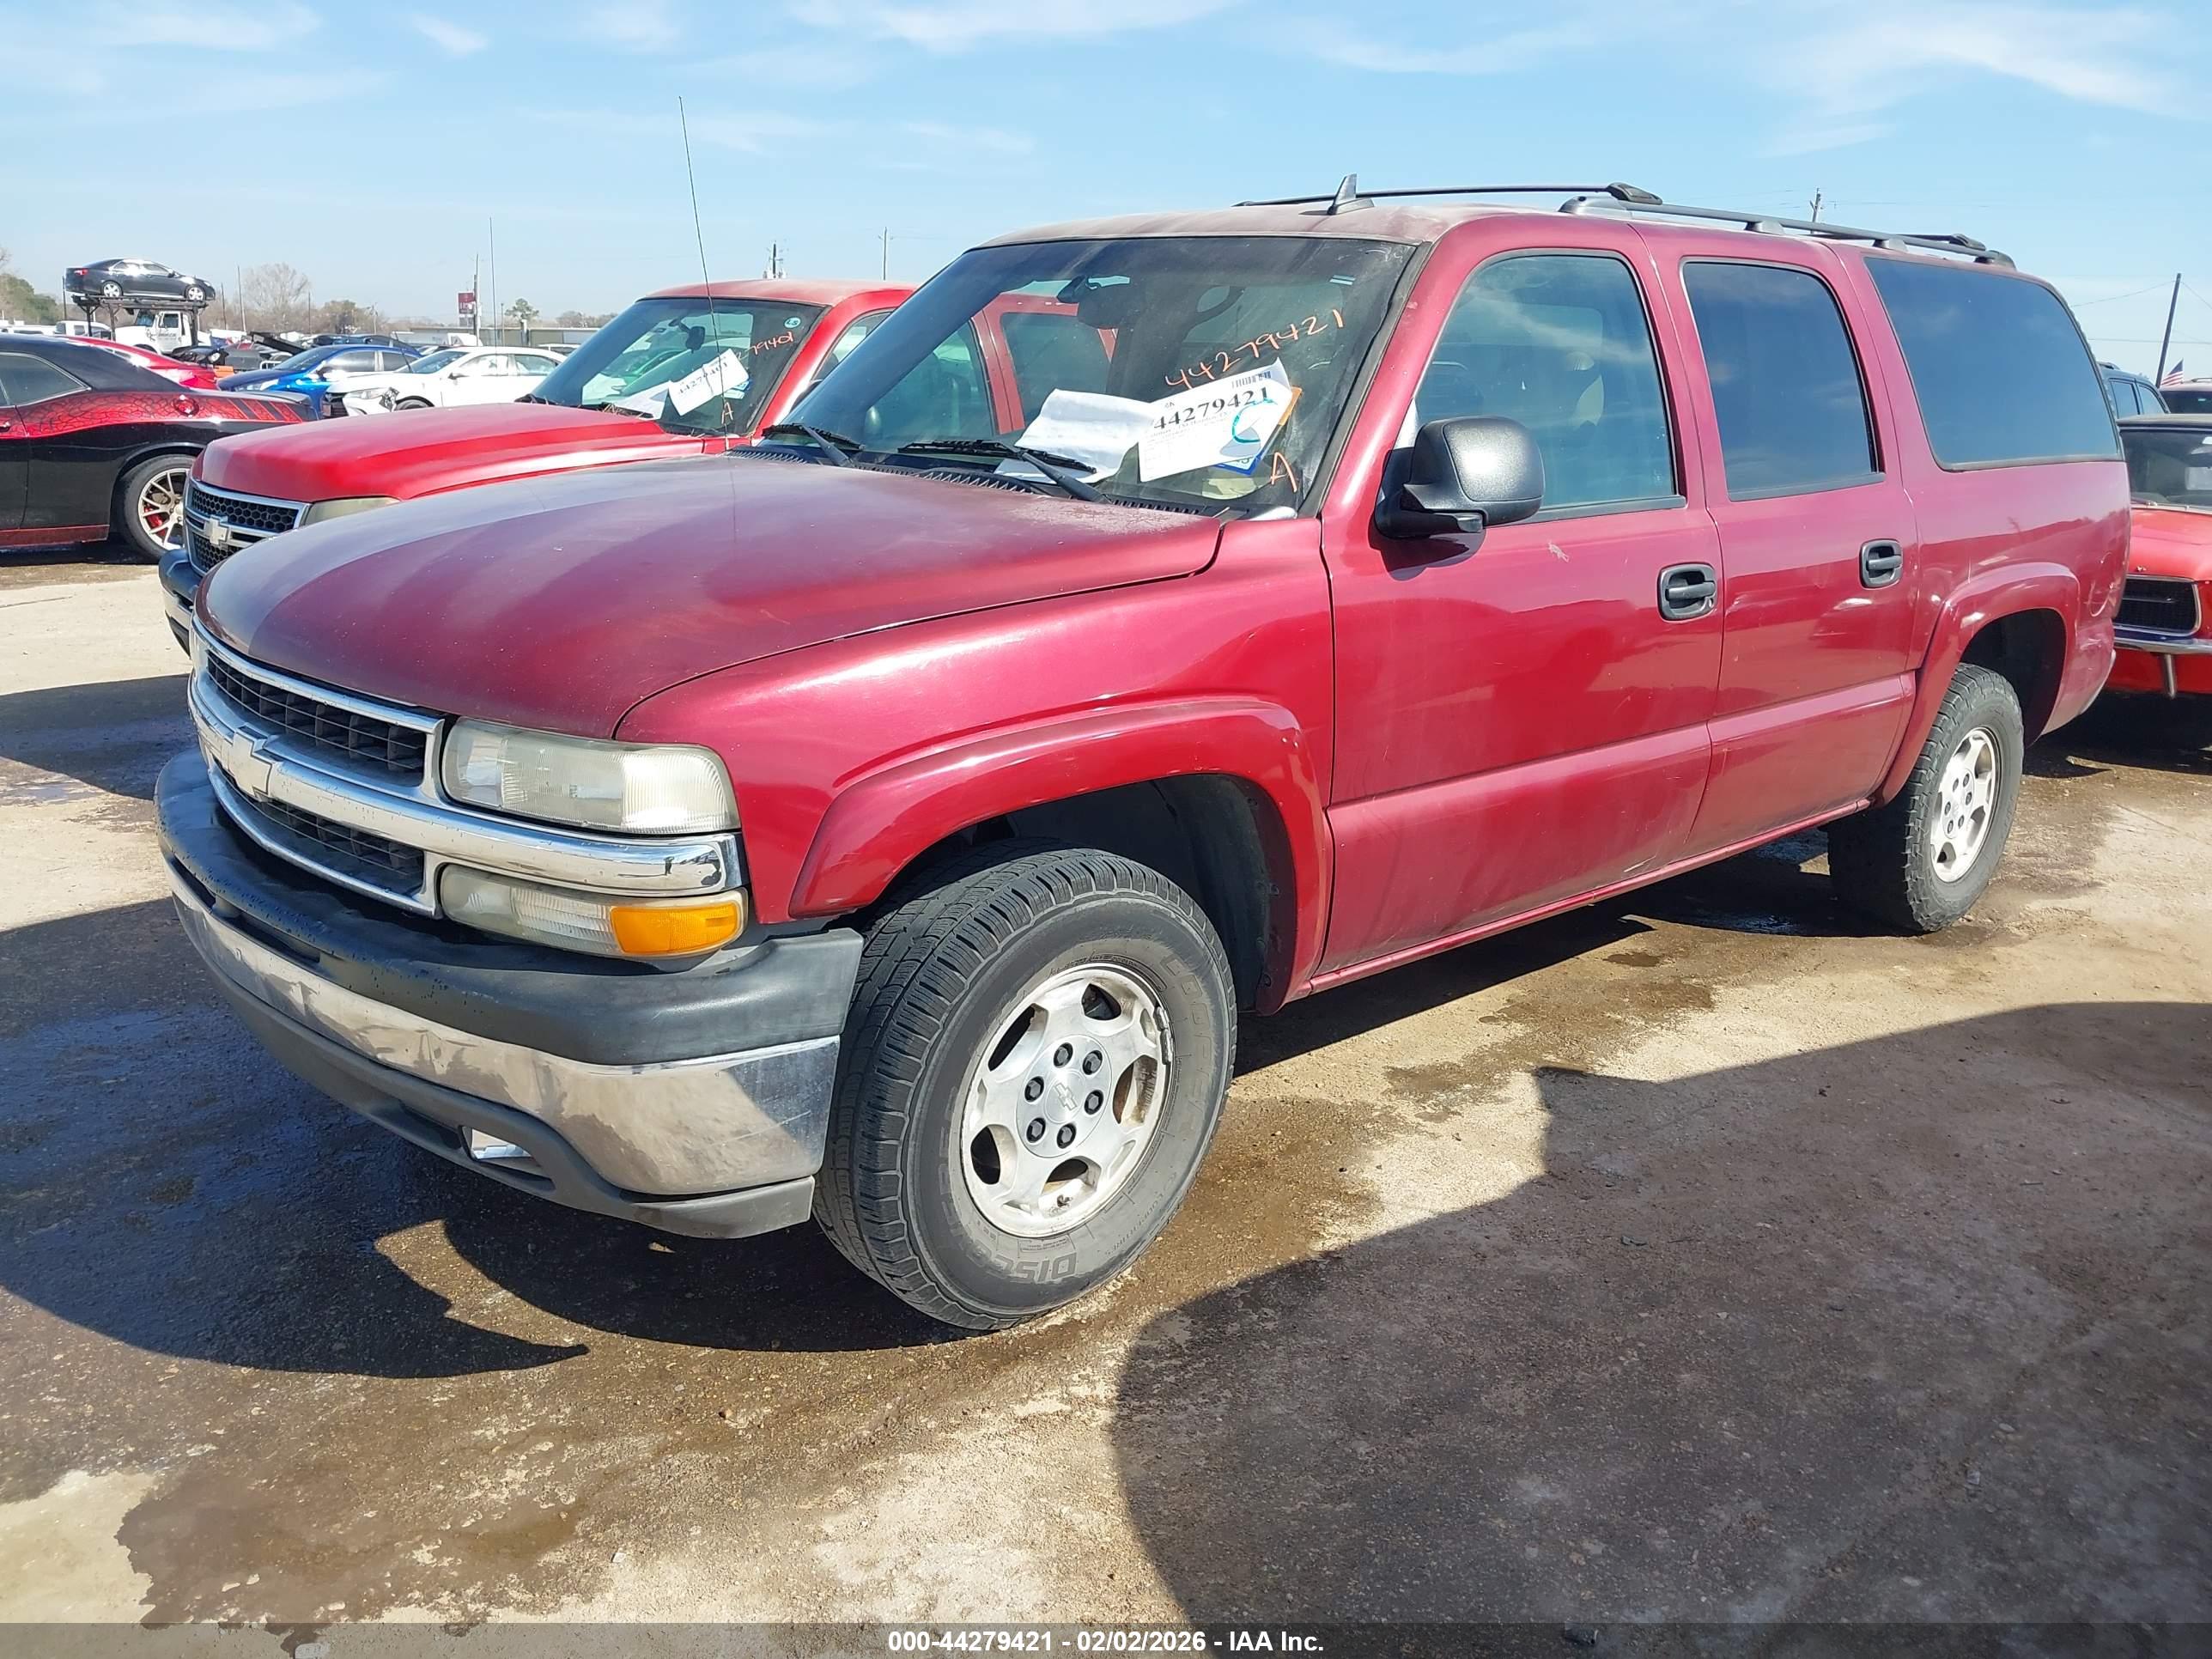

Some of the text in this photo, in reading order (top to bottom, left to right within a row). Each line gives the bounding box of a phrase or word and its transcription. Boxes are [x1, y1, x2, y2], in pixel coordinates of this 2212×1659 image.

[1165, 308, 1344, 390] 44279421
[1153, 387, 1268, 428] 44279421
[1270, 452, 1297, 493] A
